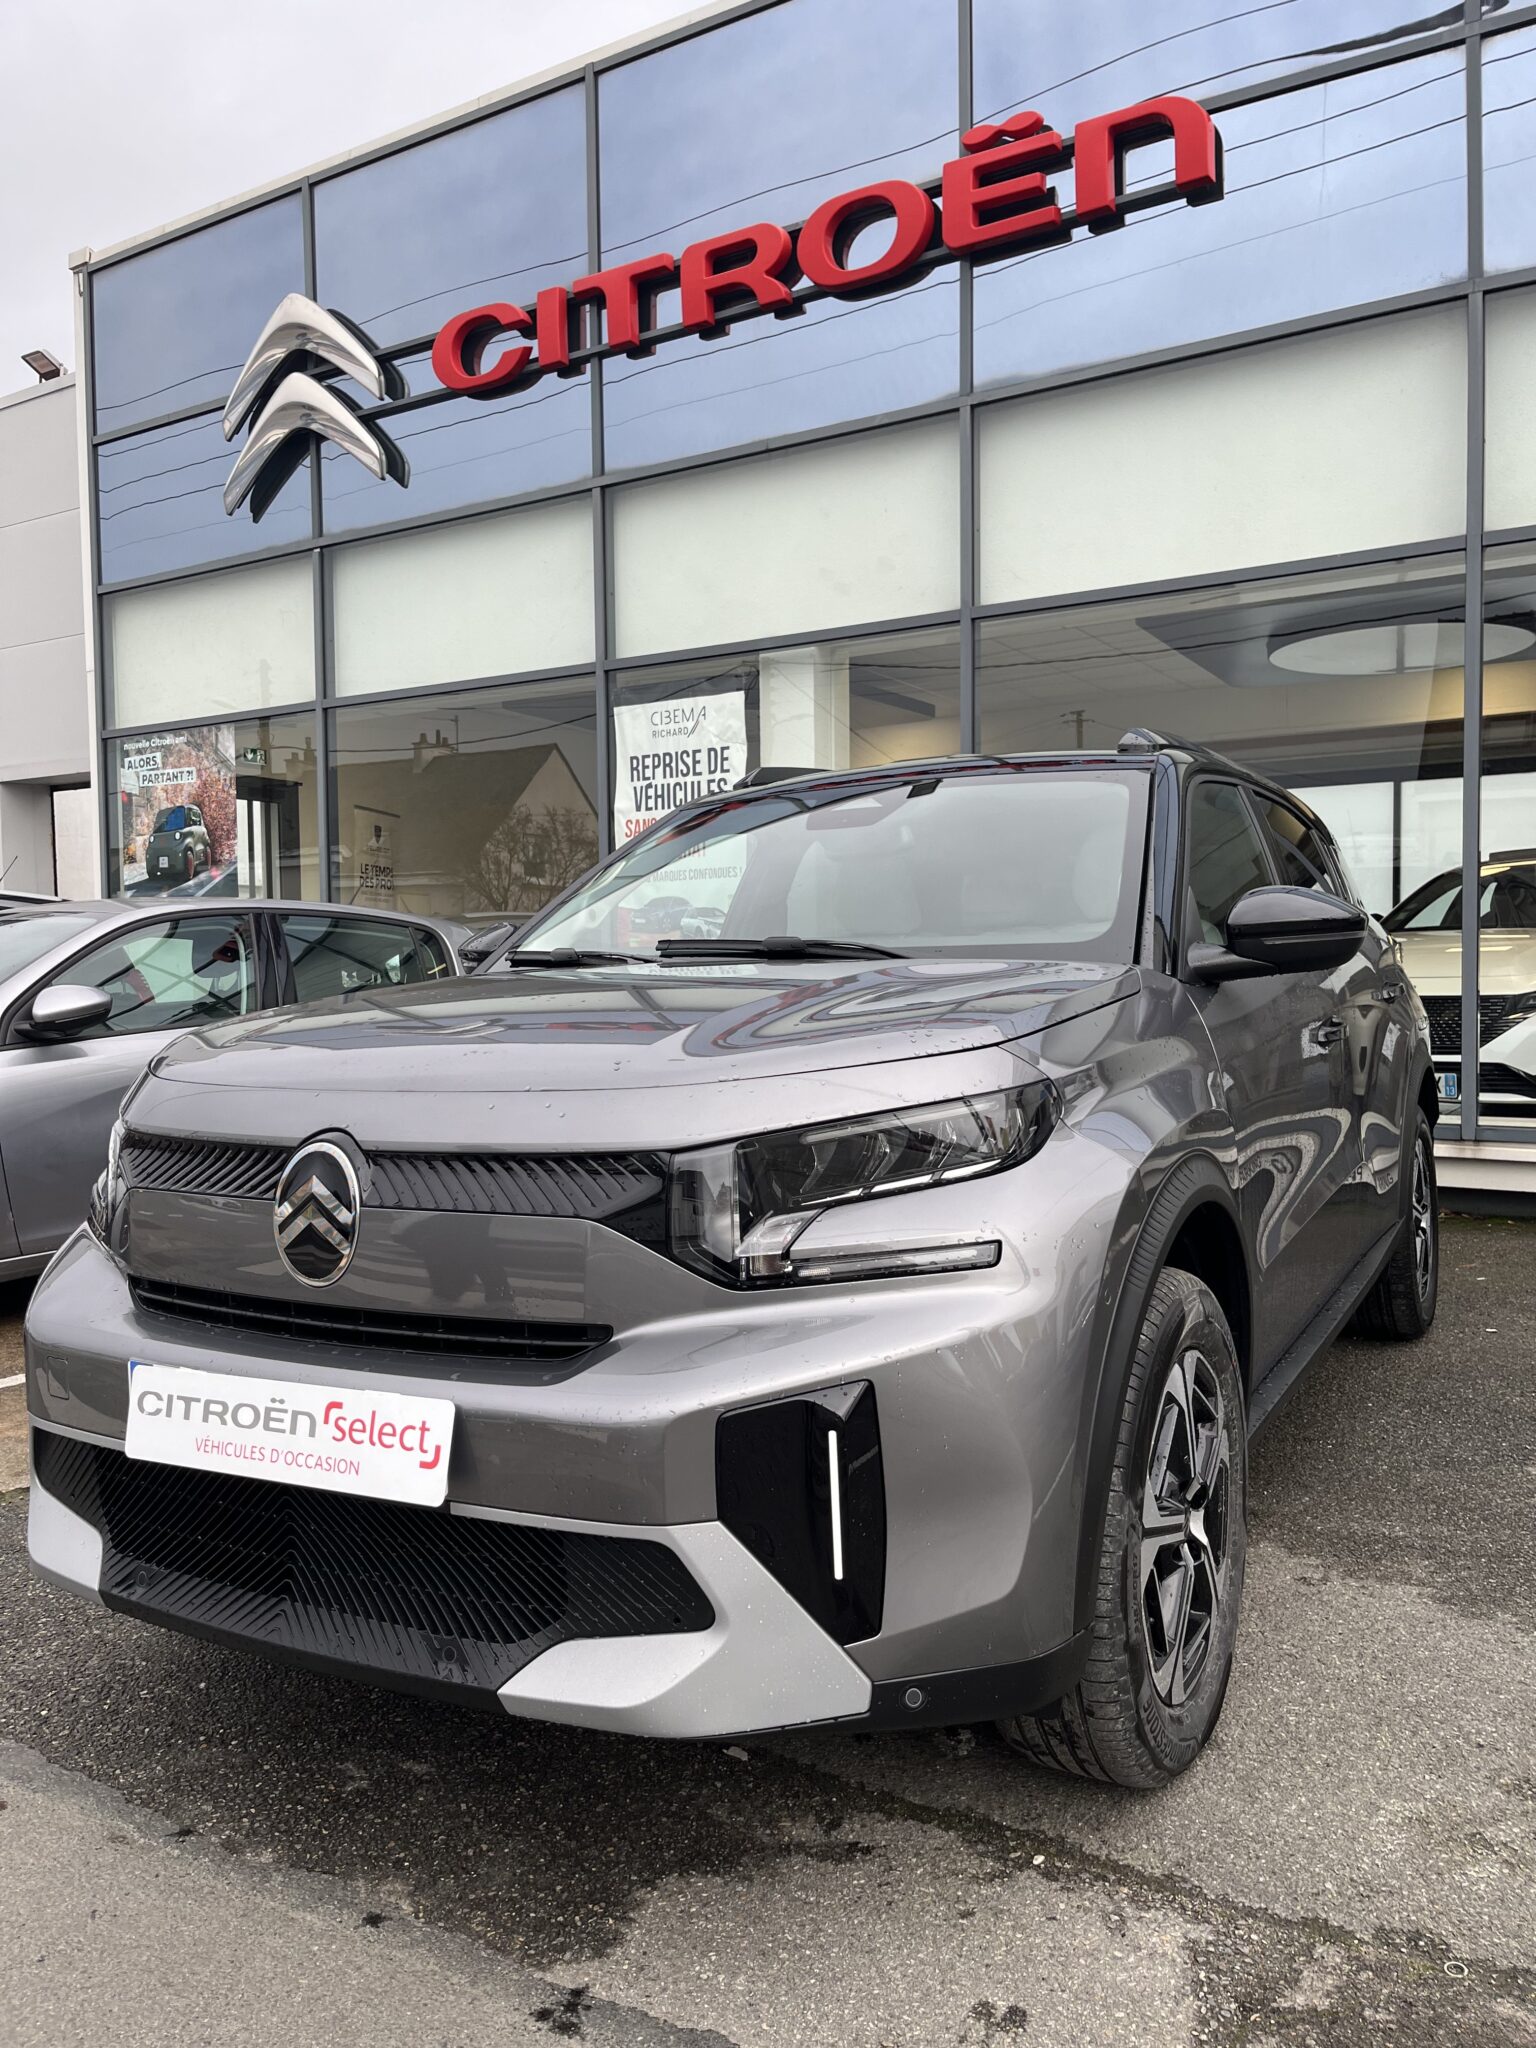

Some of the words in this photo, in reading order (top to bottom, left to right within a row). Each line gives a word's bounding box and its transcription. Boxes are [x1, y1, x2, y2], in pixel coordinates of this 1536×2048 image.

[431, 96, 1219, 396] CITROËN
[650, 705, 706, 727] CIBEMA
[652, 726, 689, 738] RICHARD
[629, 748, 703, 782] REPRISE
[707, 745, 731, 775] DE
[360, 863, 370, 875] LE
[688, 866, 738, 881] CONFONDUES
[1445, 1086, 1455, 1096] 13
[137, 1390, 317, 1438] CITROËN
[330, 1408, 433, 1455] select
[194, 1435, 266, 1463] VÉHICULES
[269, 1447, 361, 1477] D'OCCASION
